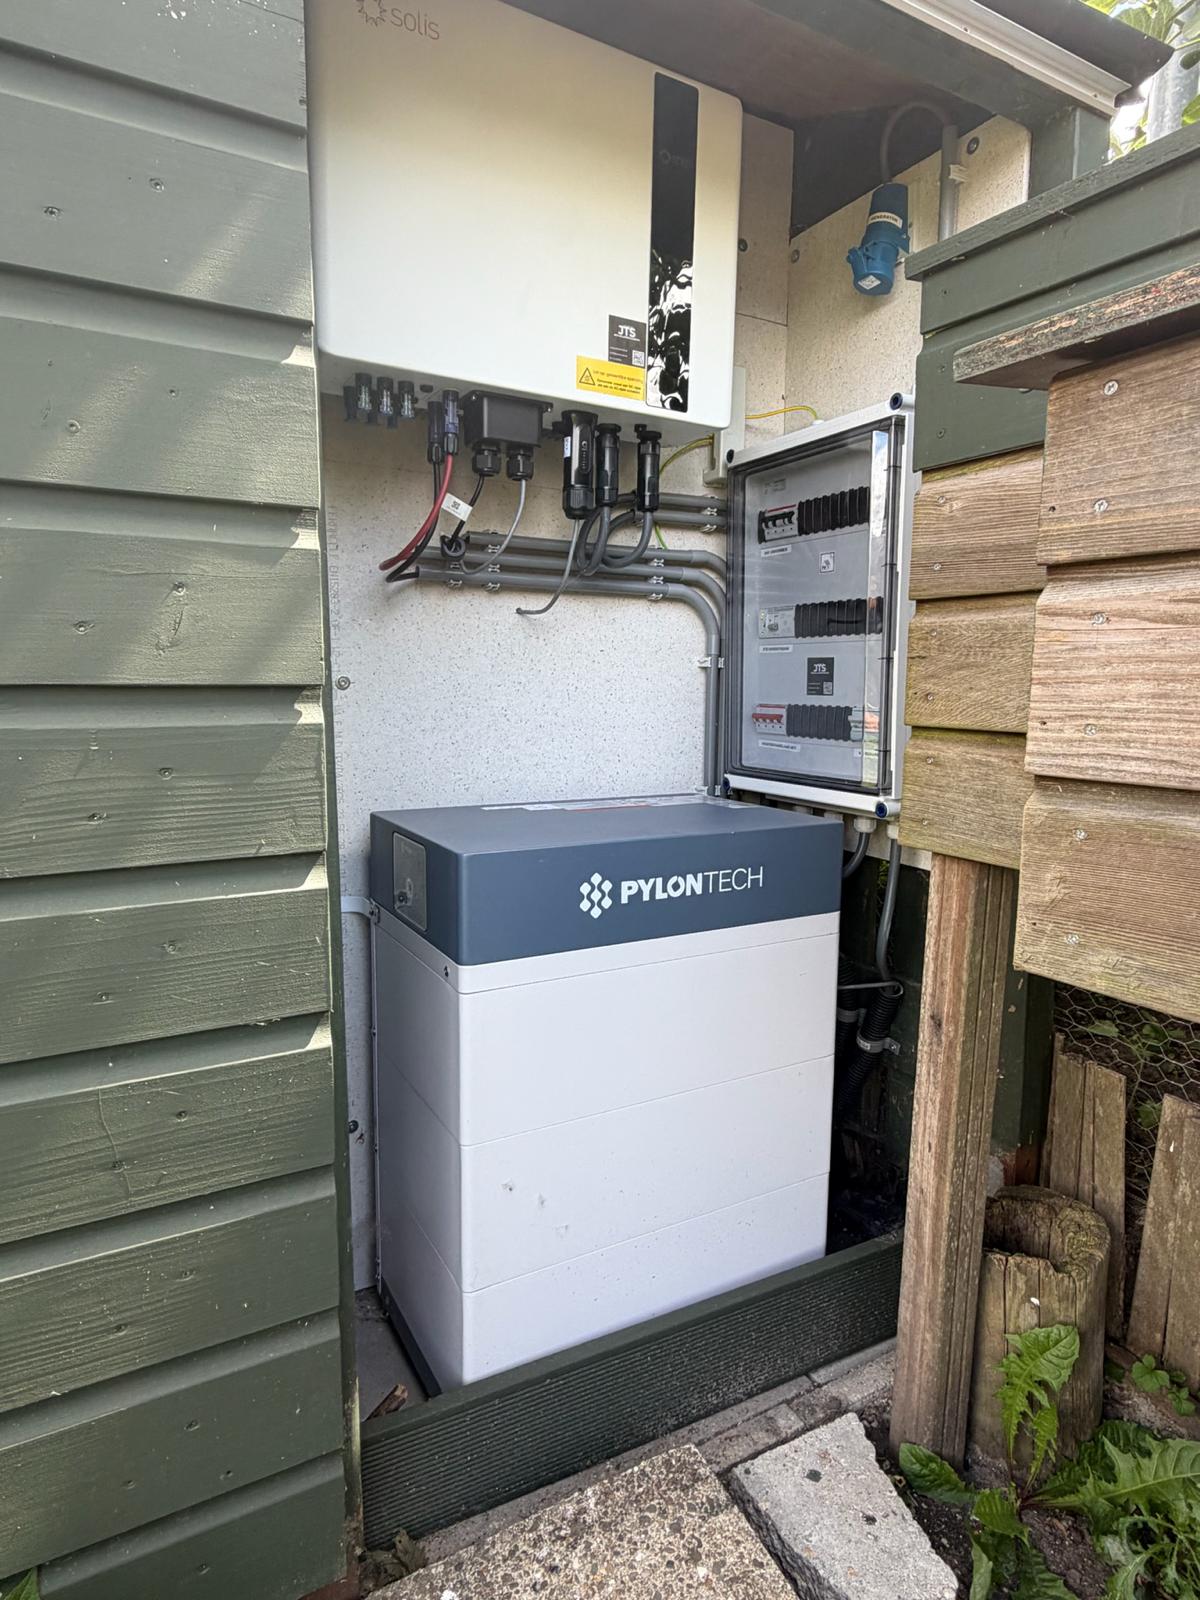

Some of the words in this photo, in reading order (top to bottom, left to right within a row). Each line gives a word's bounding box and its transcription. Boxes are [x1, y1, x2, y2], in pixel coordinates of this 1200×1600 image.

[390, 7, 440, 40] solis
[617, 324, 636, 338] JTS
[813, 663, 827, 672] JTS
[620, 865, 764, 905] PYLONTECH
